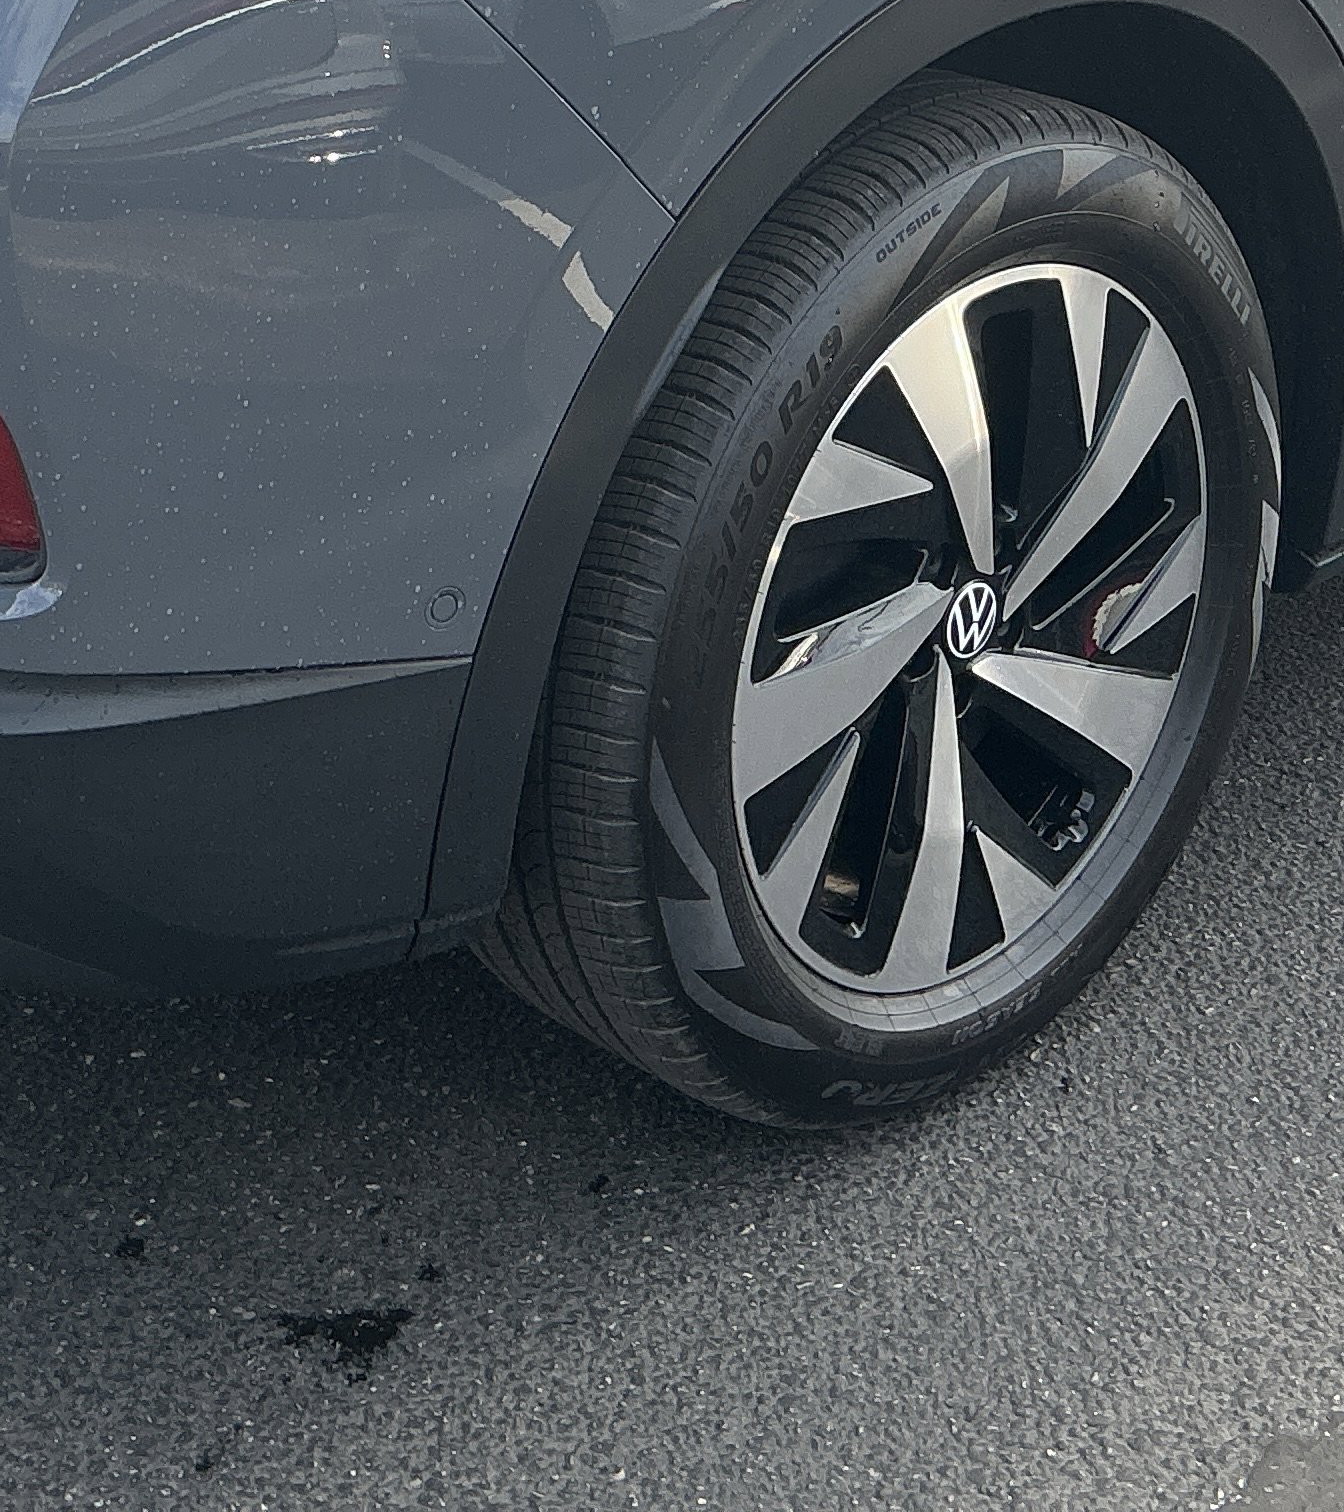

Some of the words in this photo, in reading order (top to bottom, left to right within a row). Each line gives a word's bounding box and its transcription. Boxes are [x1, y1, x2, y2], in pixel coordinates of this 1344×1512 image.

[876, 203, 942, 263] OUTSIDE
[1173, 191, 1251, 326] PIRELLI
[778, 324, 844, 435] R19
